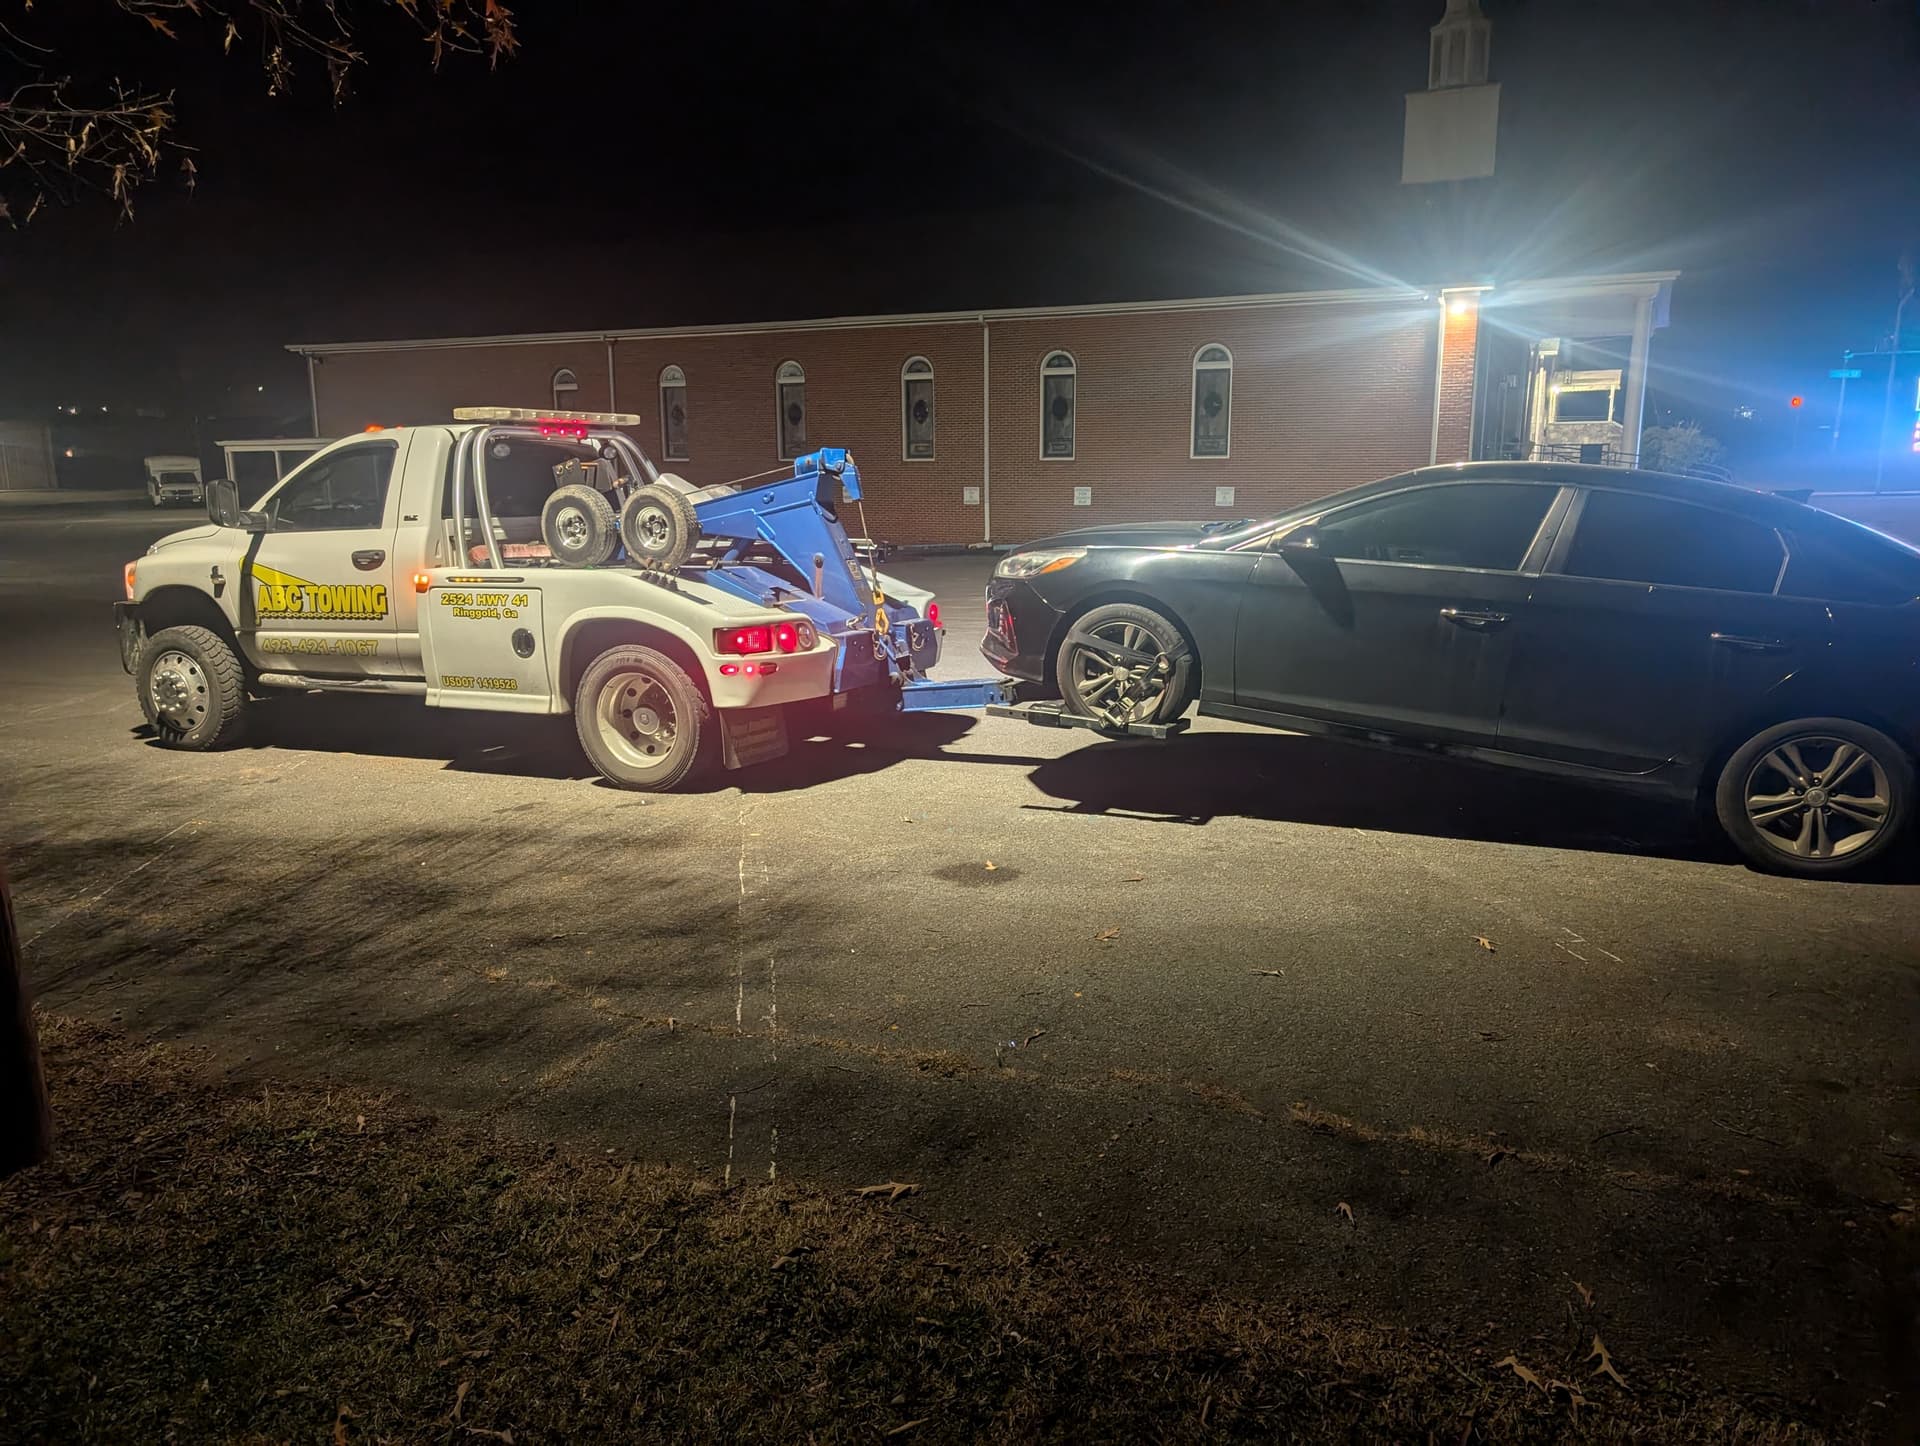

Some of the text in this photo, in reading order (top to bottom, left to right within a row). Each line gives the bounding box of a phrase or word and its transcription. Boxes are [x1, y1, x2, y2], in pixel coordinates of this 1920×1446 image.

[258, 585, 388, 615] ABC TOWING
[441, 593, 528, 607] 2524 HWY 41
[453, 607, 518, 619] Ringgold, Ga
[262, 638, 379, 656] 423-421-1067
[442, 676, 517, 690] USDOT 1419528
